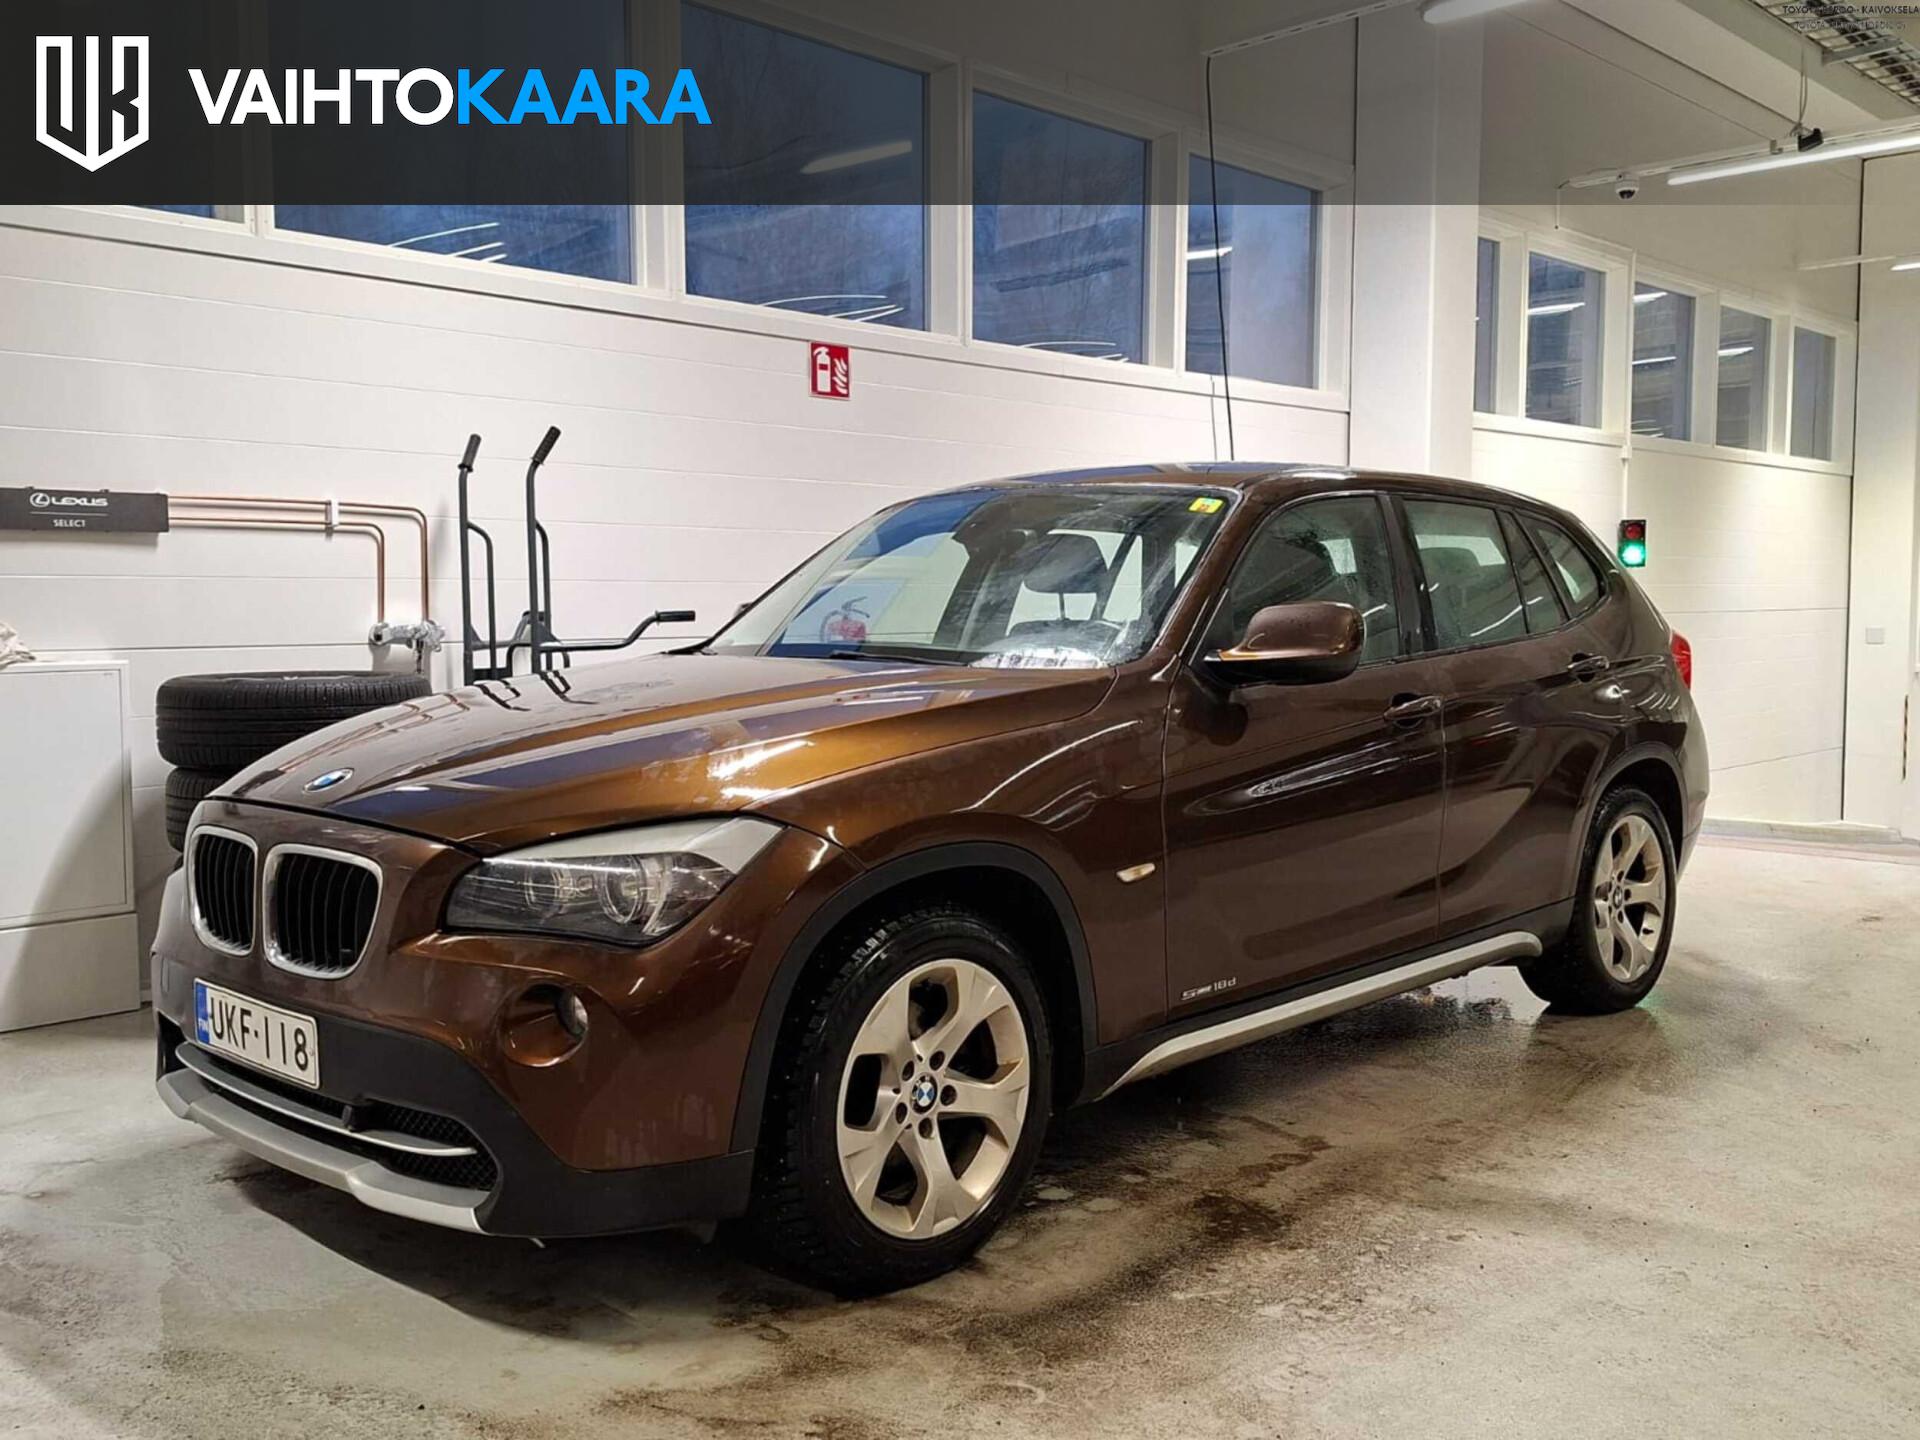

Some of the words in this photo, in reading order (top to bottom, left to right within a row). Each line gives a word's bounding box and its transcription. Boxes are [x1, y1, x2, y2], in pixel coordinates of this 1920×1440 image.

[51, 496, 109, 506] LEXUS
[53, 519, 86, 527] SELECT
[210, 997, 309, 1072] UKF-118
